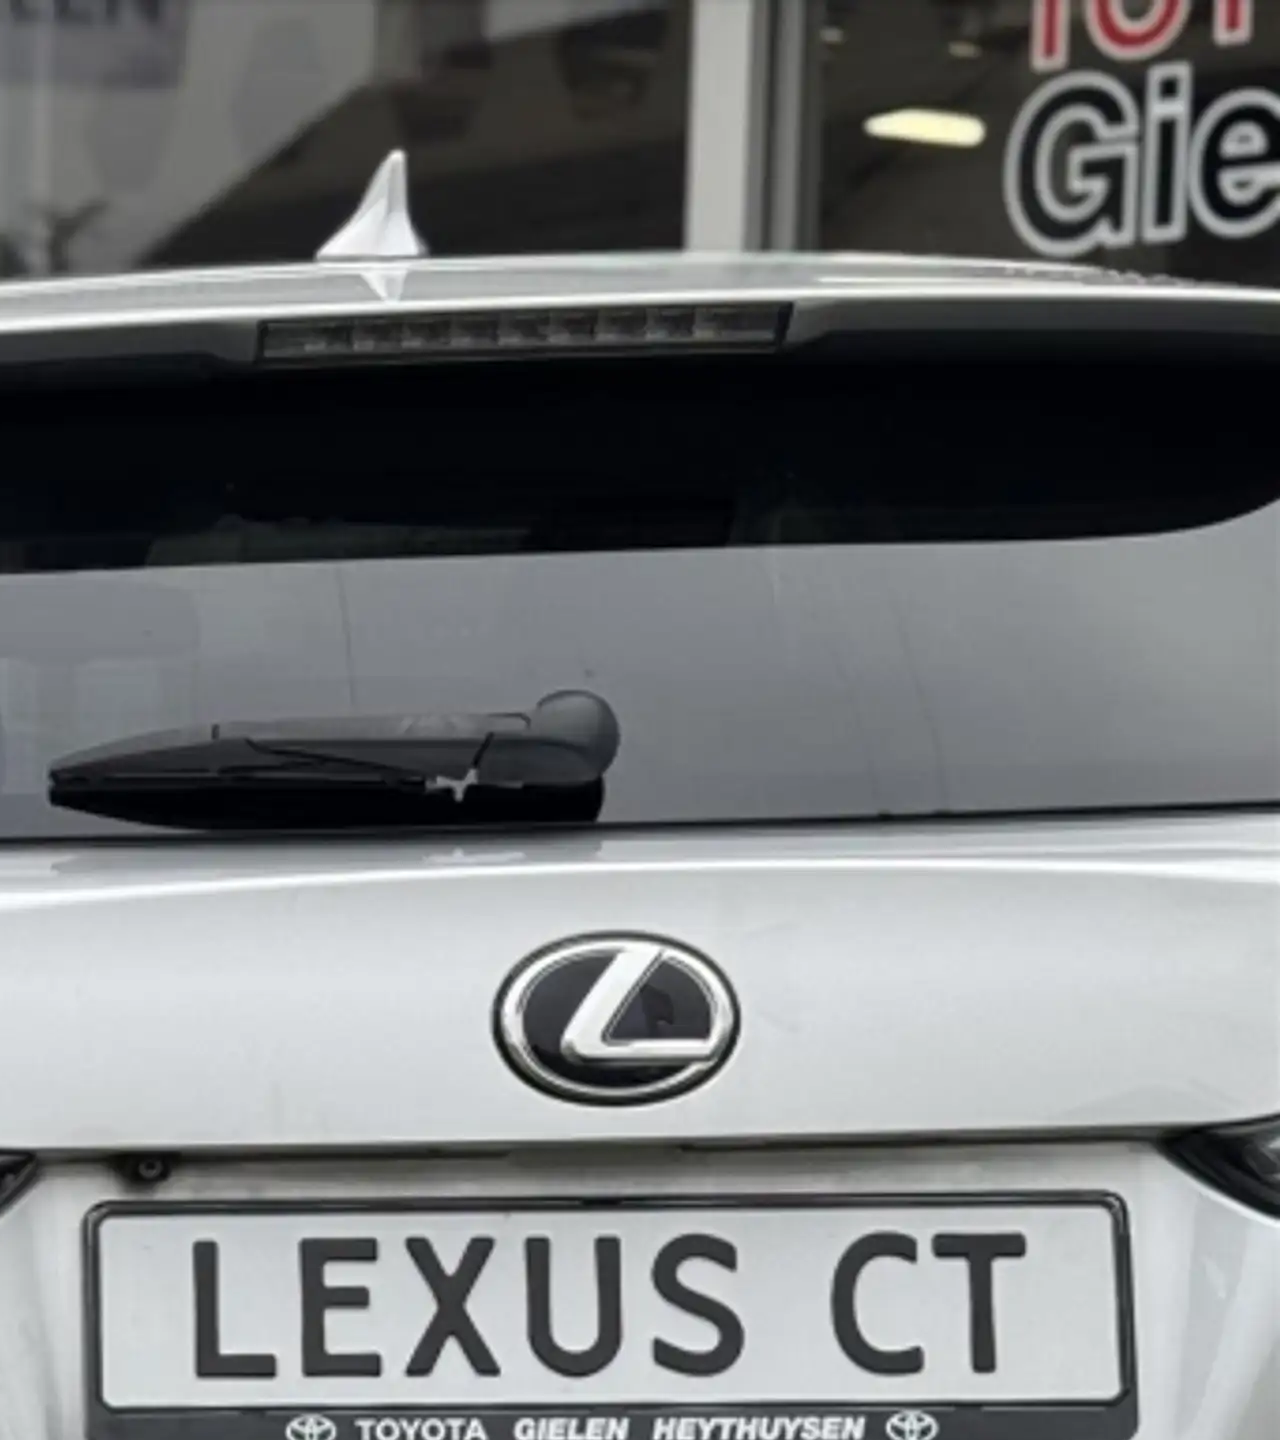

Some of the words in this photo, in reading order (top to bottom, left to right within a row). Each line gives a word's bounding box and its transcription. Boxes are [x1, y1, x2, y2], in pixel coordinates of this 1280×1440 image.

[1003, 61, 1280, 258] Gie
[192, 1233, 745, 1380] LEXUS
[830, 1231, 1027, 1377] CT
